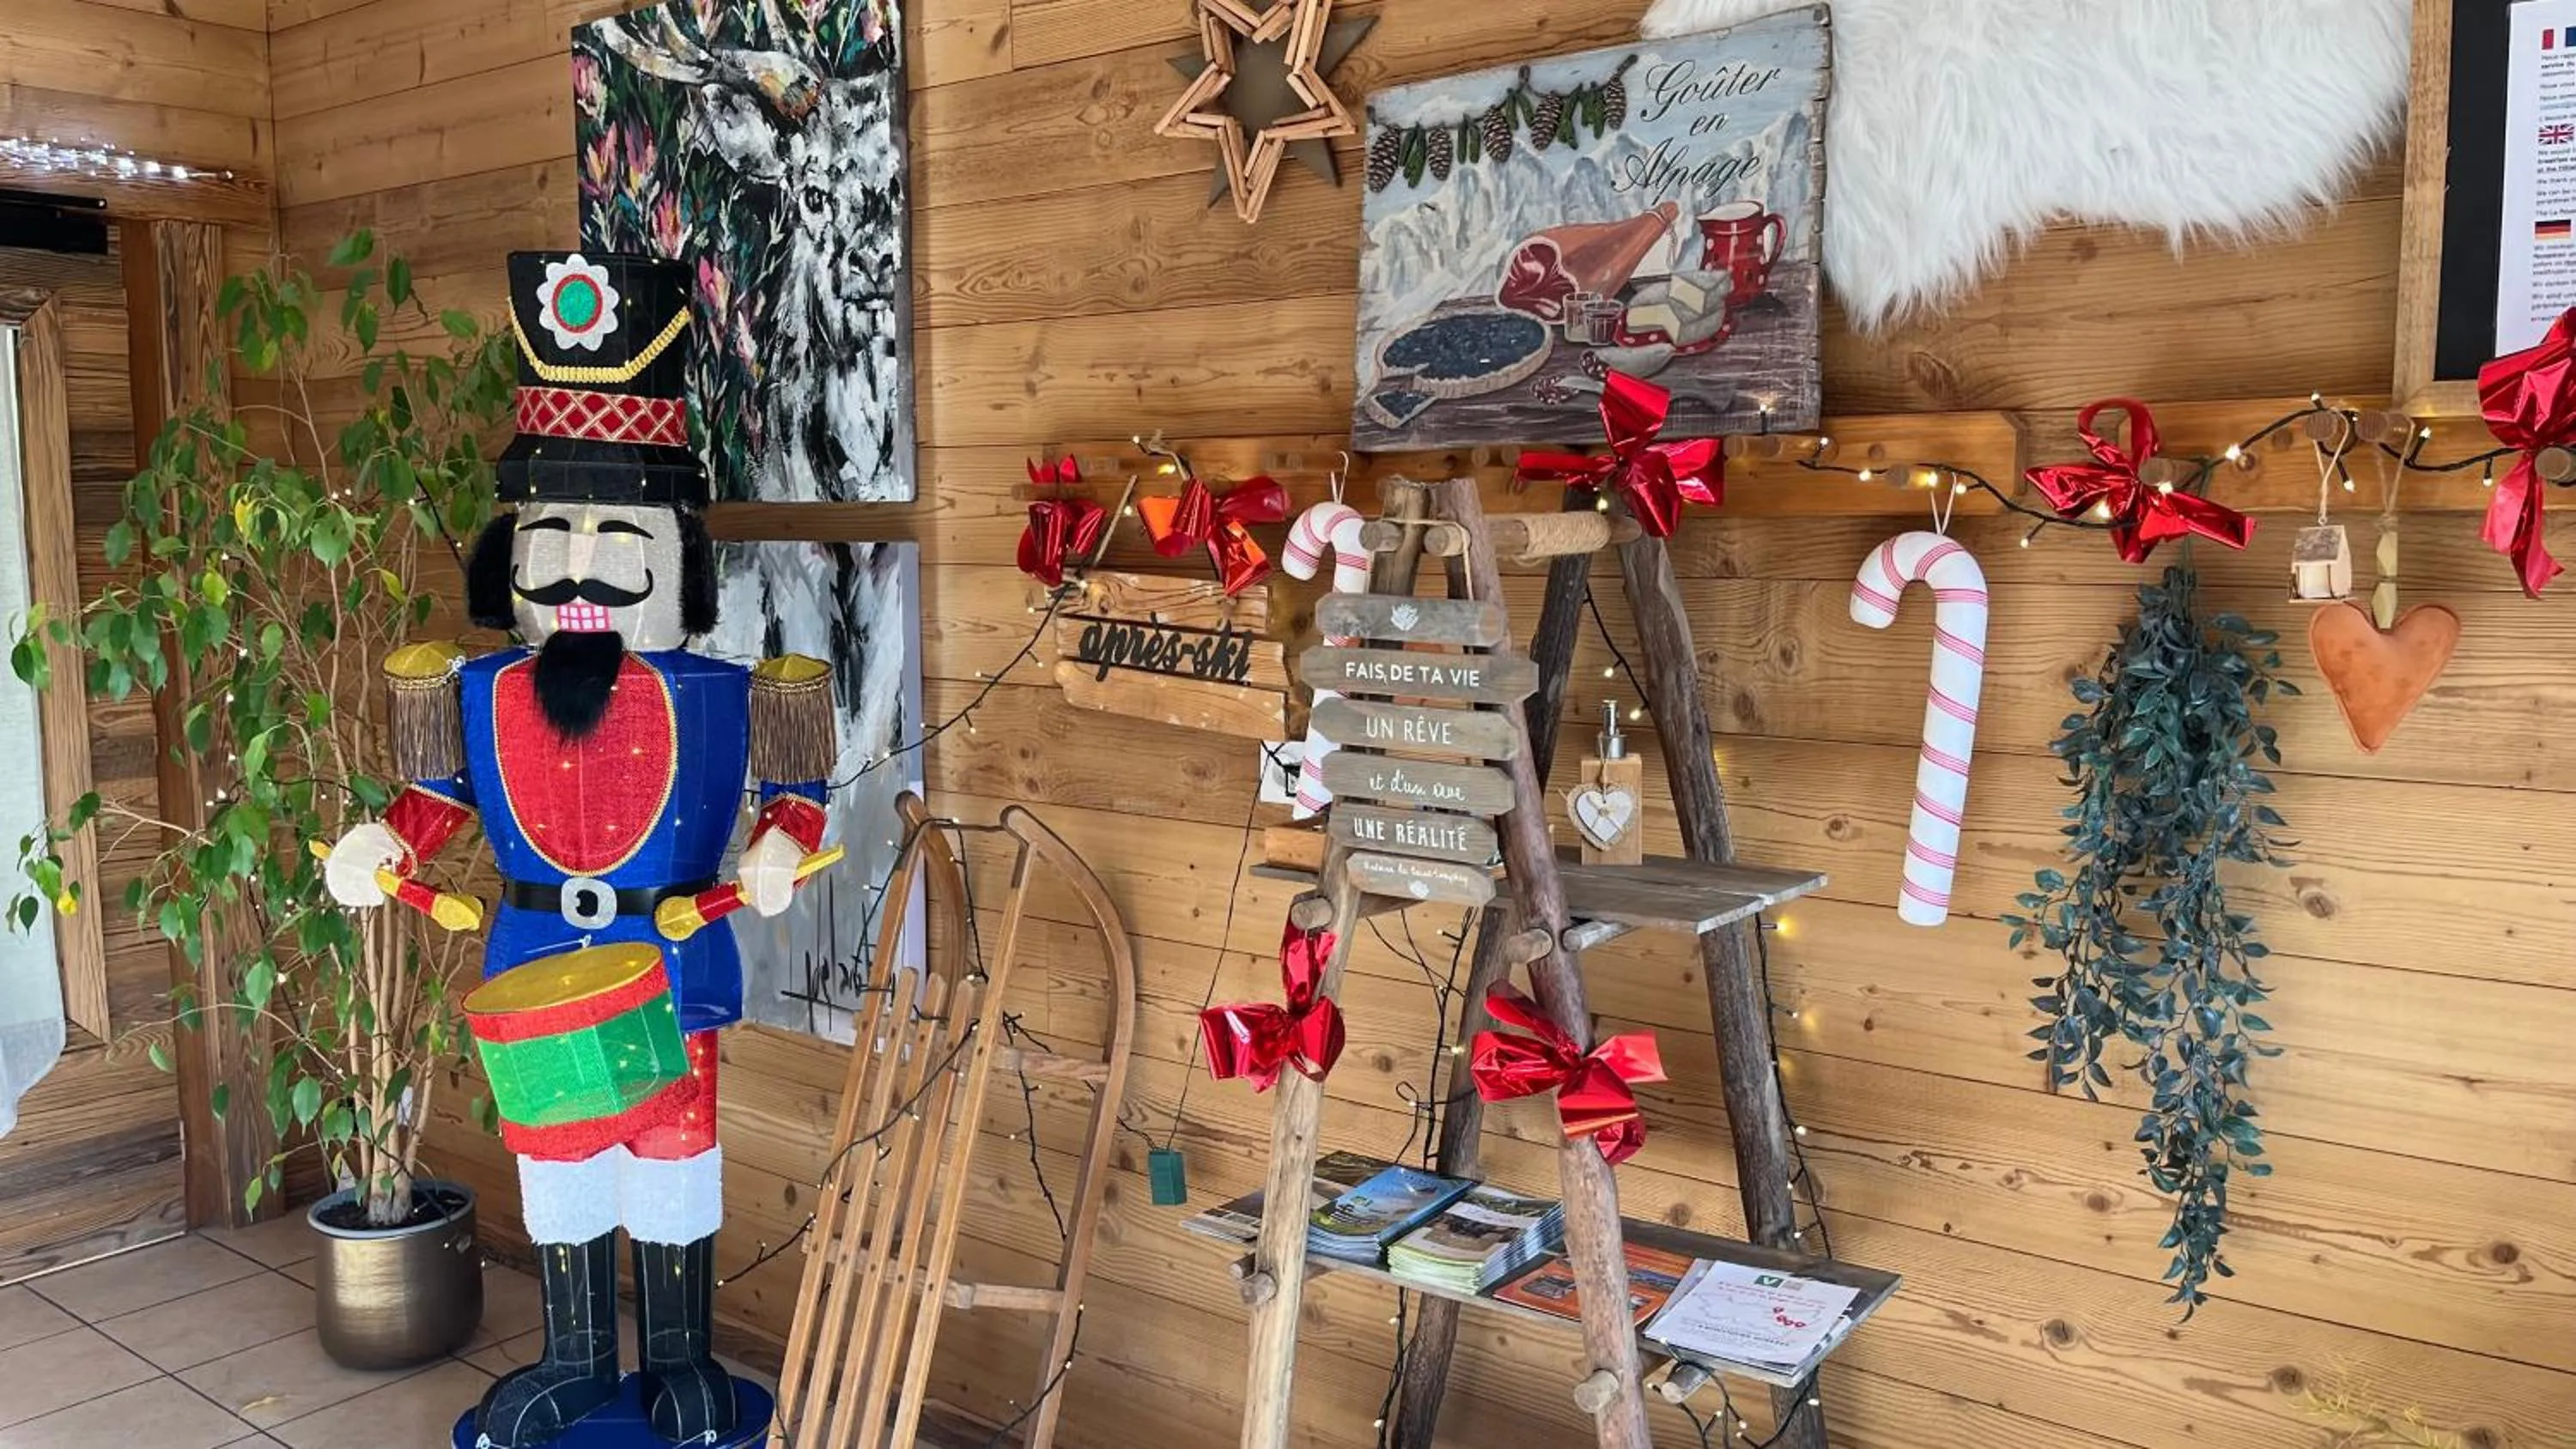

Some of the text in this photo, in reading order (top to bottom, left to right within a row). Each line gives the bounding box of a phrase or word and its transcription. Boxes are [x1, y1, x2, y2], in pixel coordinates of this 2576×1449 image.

[1640, 59, 1781, 122] Goûter
[1689, 112, 1728, 136] en
[1611, 136, 1760, 206] Alpage
[1346, 661, 1480, 688] FAIS DE TA VIE
[1366, 714, 1452, 744] UN RÊVE
[1370, 773, 1385, 791] et
[1354, 817, 1467, 852] UNE RÉALITÉ
